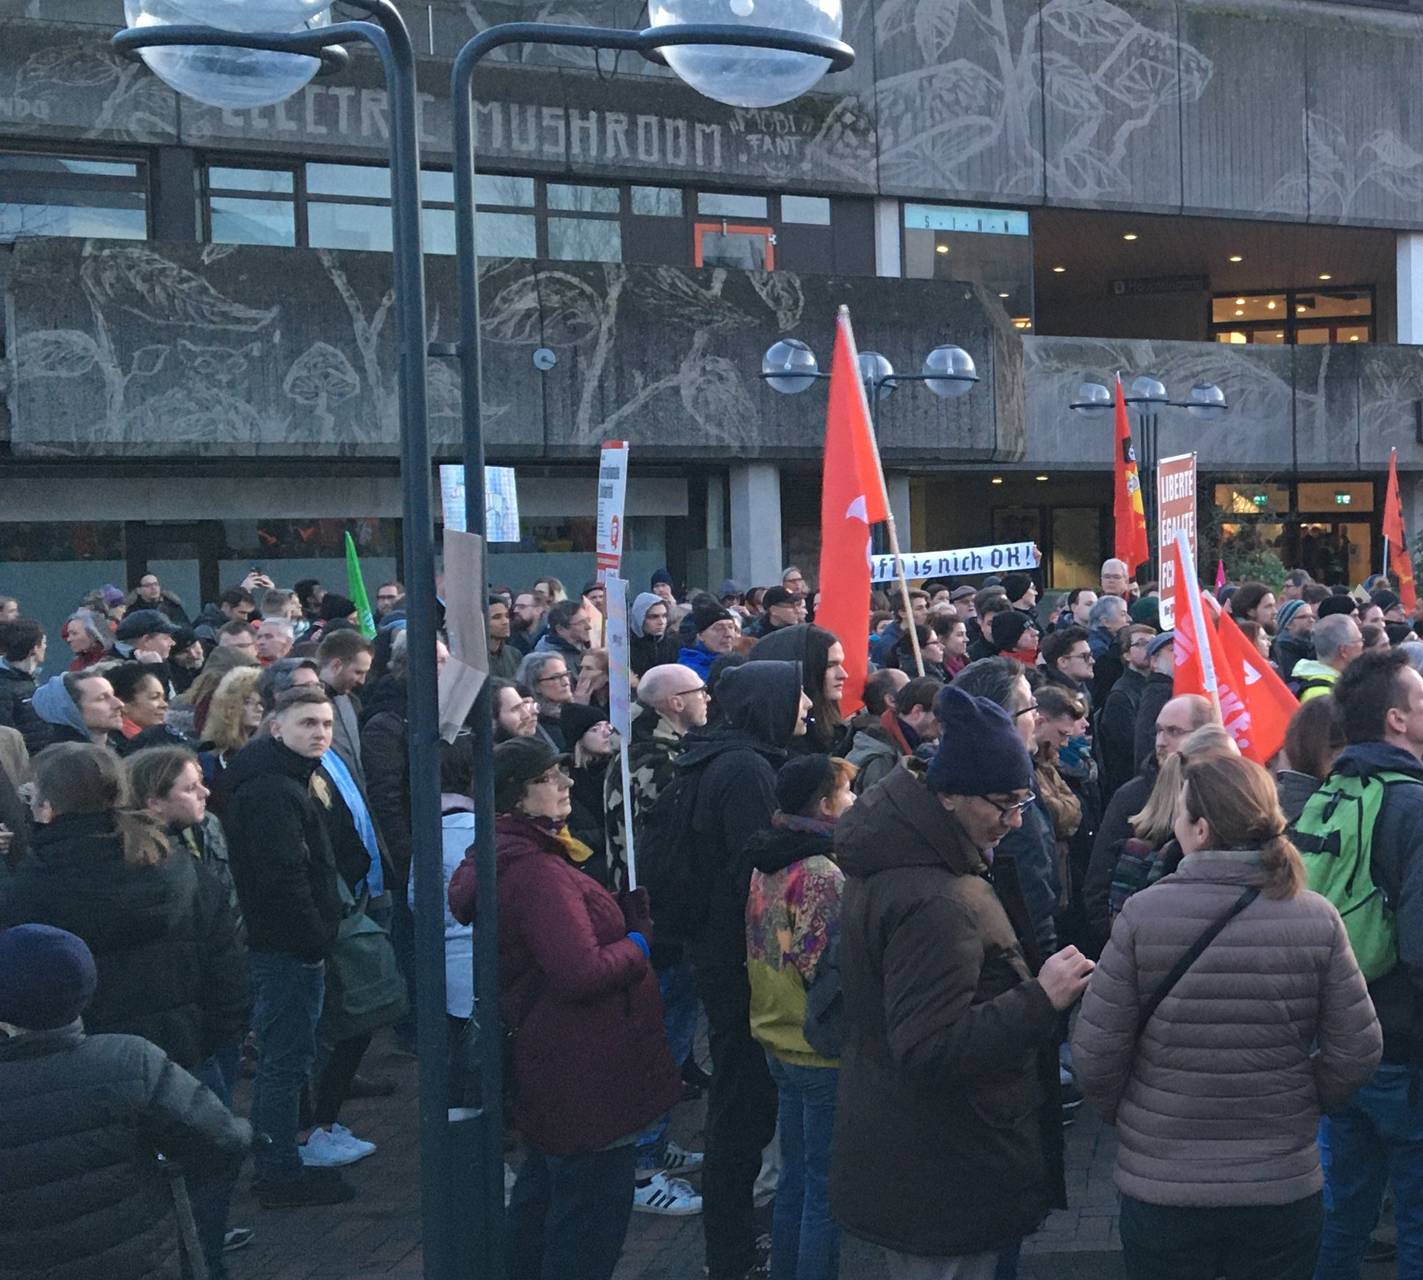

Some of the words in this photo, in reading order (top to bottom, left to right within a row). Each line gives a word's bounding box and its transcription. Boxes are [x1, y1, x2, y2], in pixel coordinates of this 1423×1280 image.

[473, 100, 722, 167] MUSHROOM
[1161, 460, 1193, 503] LIBERTÉ
[912, 555, 932, 576] is
[938, 552, 984, 576] nich
